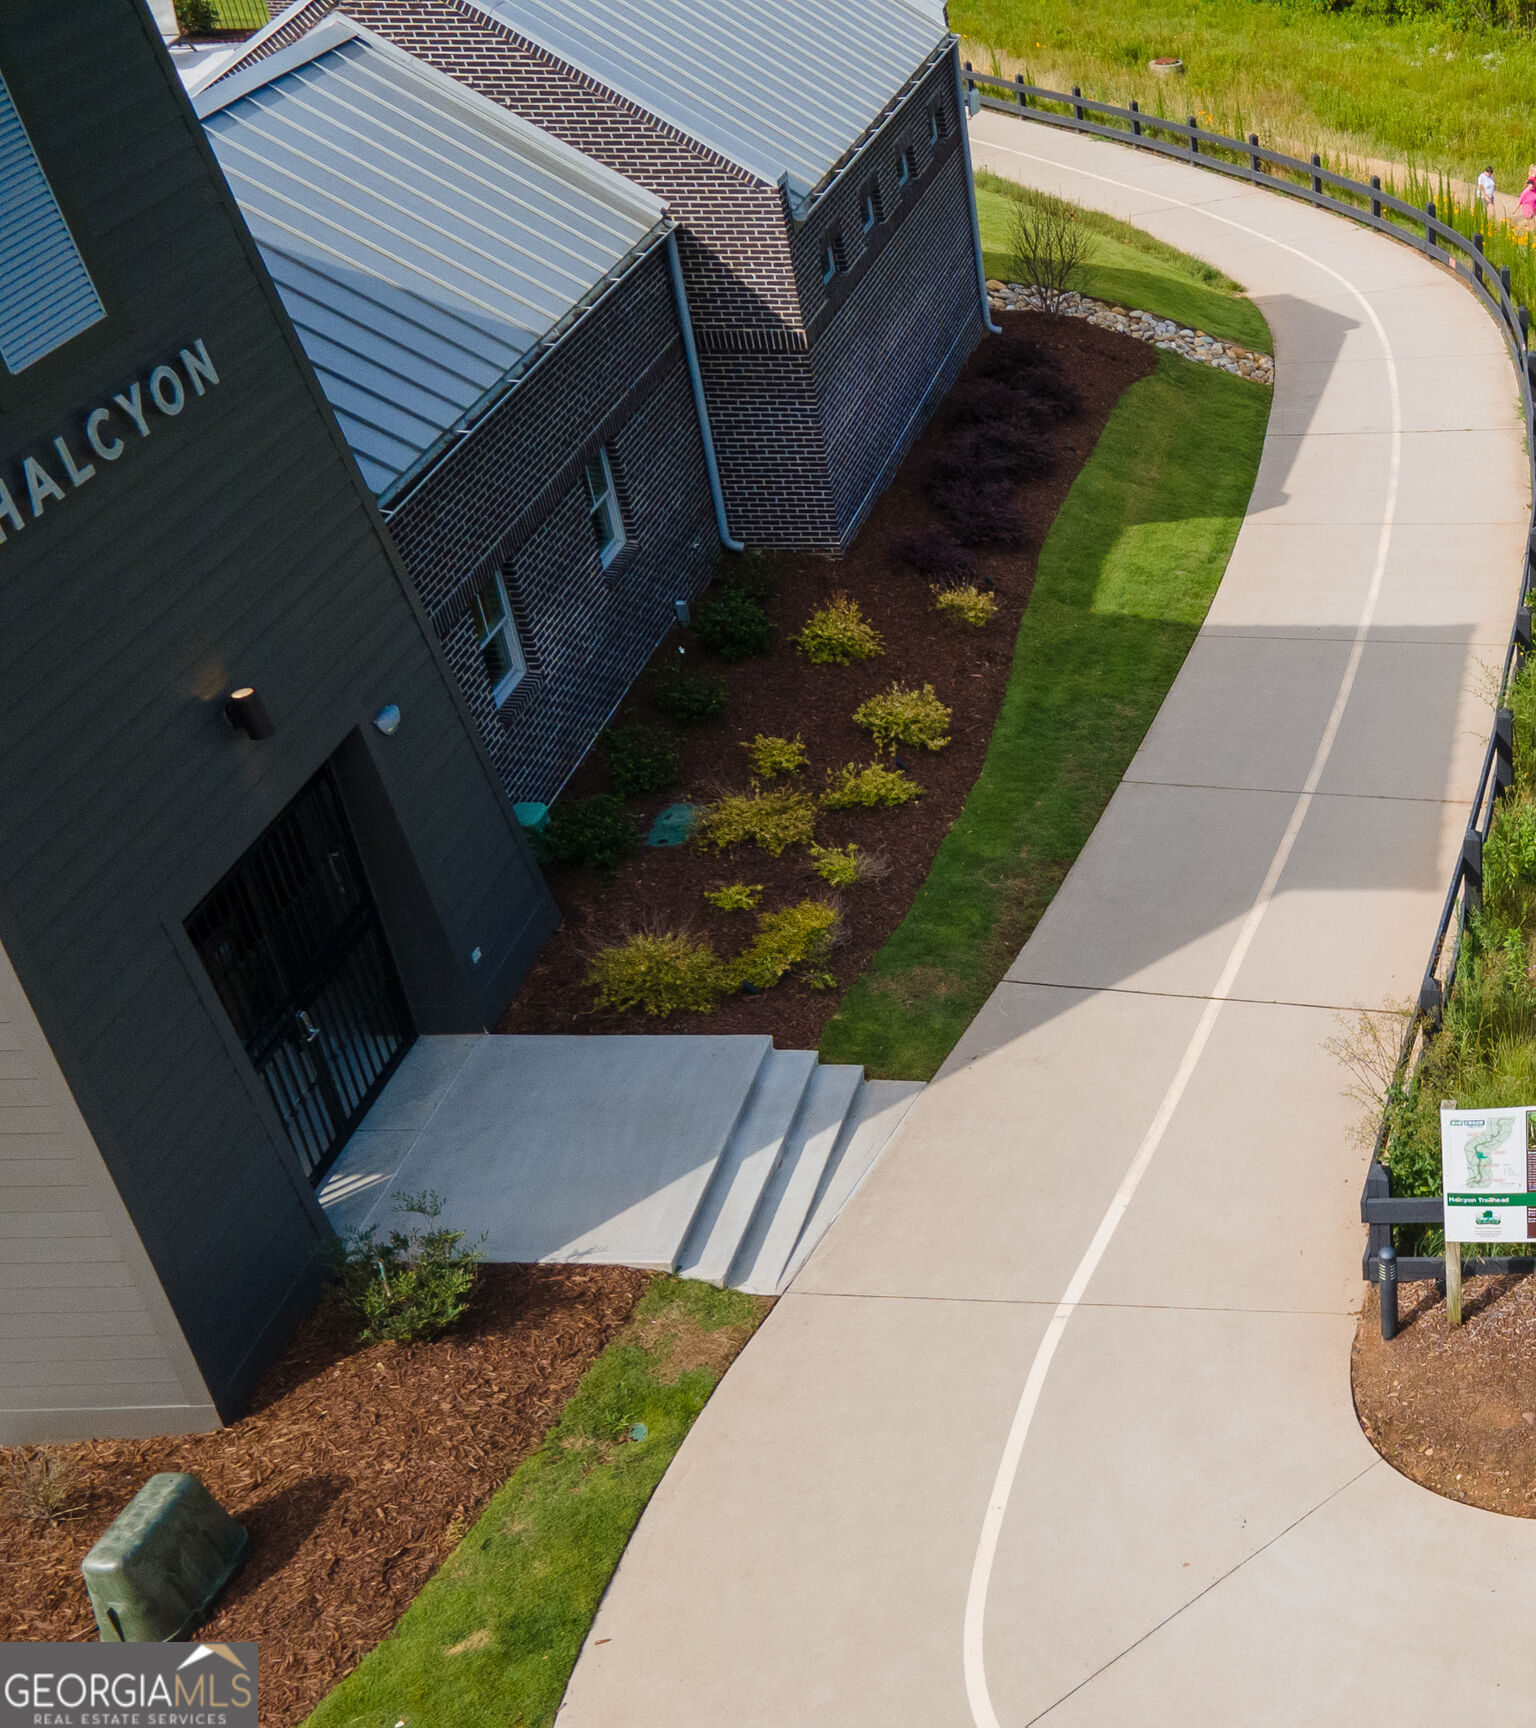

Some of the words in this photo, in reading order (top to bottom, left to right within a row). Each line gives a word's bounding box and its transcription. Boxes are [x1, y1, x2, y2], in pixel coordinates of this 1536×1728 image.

[0, 338, 220, 544] HALCYON
[1448, 1196, 1477, 1204] Halcyon
[1478, 1196, 1510, 1204] Trailhead
